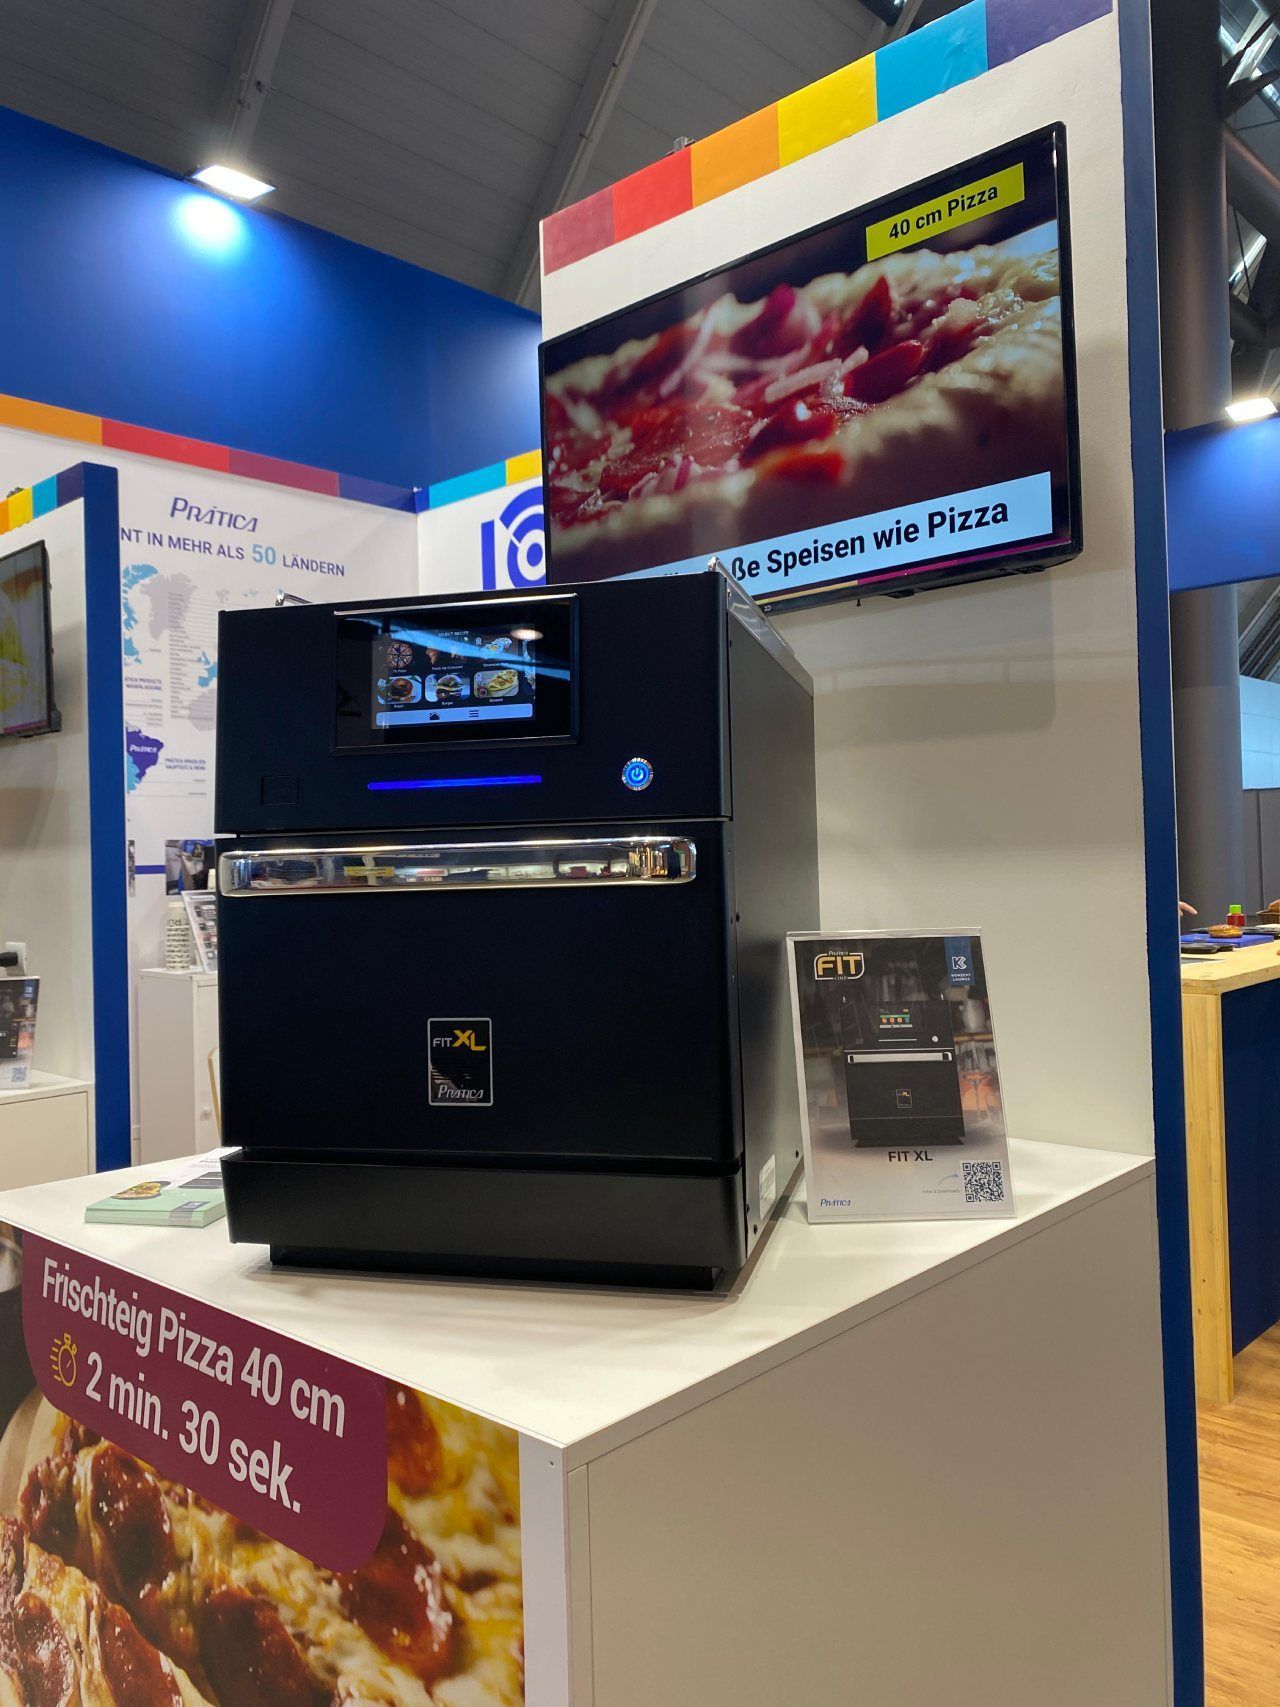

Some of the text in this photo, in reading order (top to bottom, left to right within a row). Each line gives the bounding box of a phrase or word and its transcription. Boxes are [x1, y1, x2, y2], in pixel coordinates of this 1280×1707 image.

[889, 186, 998, 239] 40 cm Pizza
[147, 532, 163, 547] IN
[168, 535, 212, 555] MEHR
[216, 544, 245, 560] ALS
[251, 543, 276, 565] 50
[283, 553, 345, 577] LÄNDERN
[766, 535, 866, 578] Speisen
[873, 519, 919, 549] wie
[927, 502, 1010, 540] Pizza
[817, 955, 861, 975] FIT
[888, 1150, 933, 1162] FIT XL
[42, 1257, 346, 1438] Frischteig Pizza 40 cm
[86, 1351, 301, 1514] 2 min. 30 sek.
